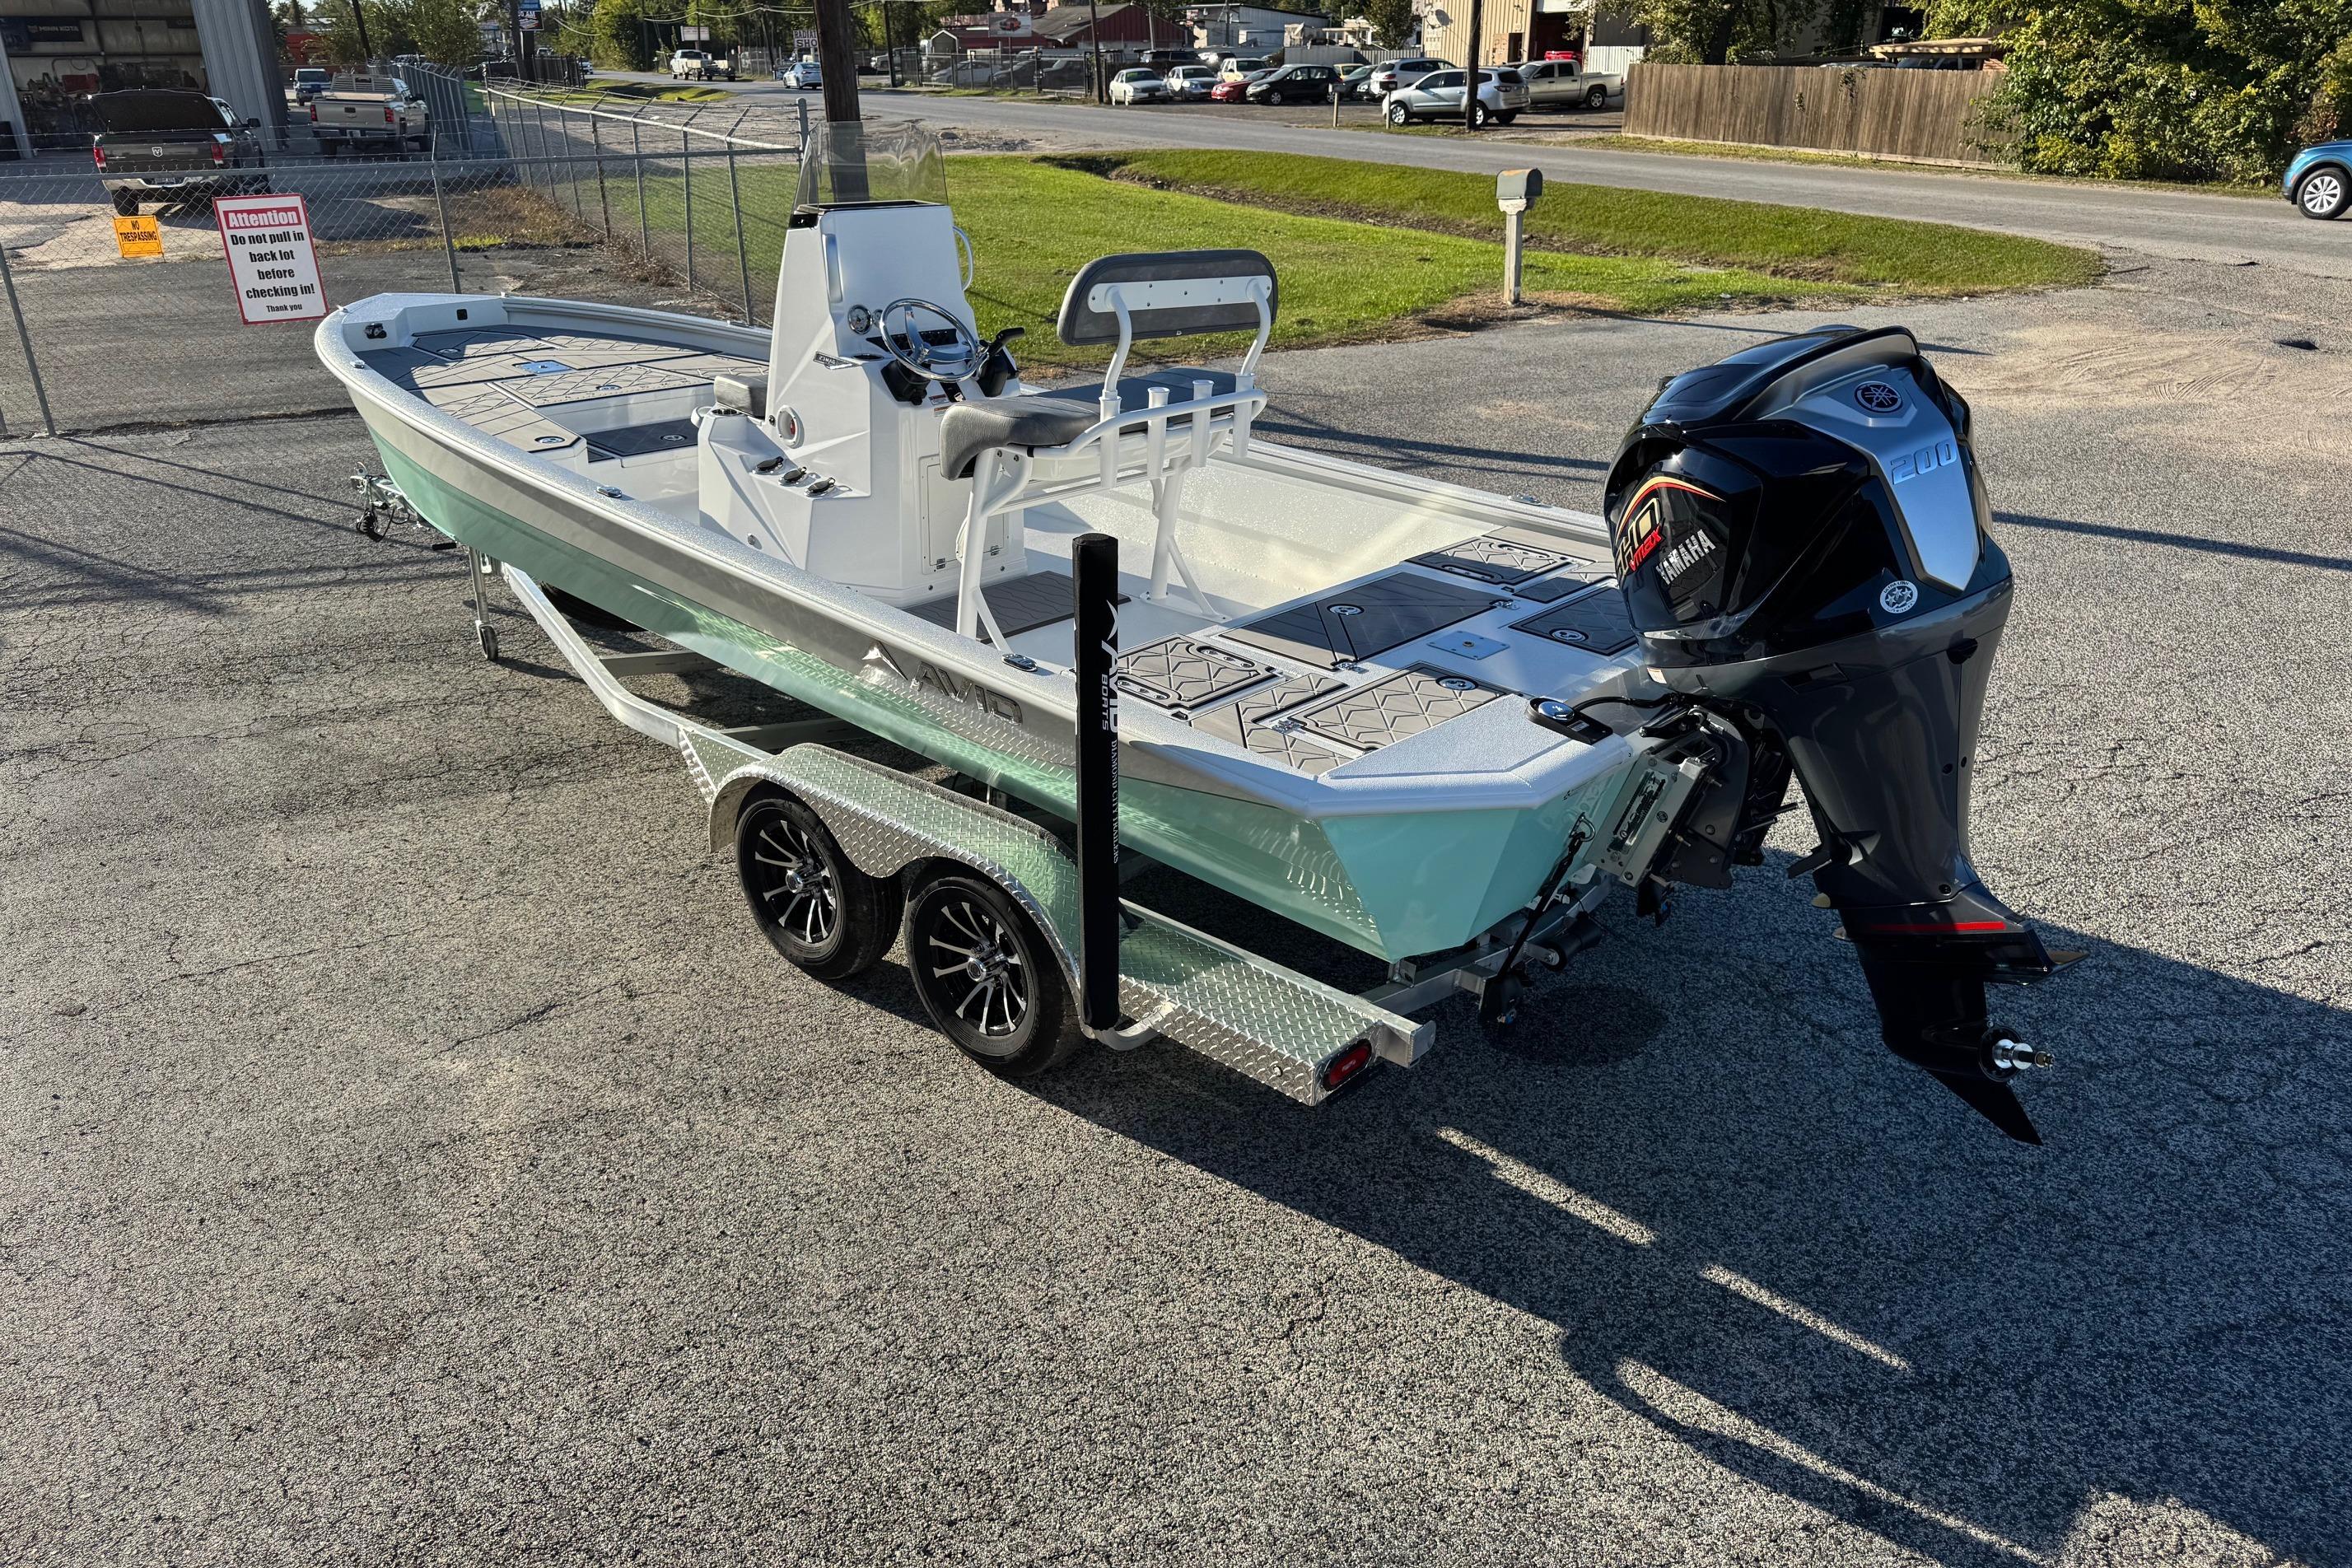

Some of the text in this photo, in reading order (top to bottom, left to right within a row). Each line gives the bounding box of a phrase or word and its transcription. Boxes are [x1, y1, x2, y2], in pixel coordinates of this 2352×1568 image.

[131, 220, 140, 231] NO
[228, 210, 298, 227] Attention
[119, 231, 157, 242] TRESPASSING
[231, 231, 305, 245] Do not pull in
[249, 250, 296, 263] back lot
[257, 268, 296, 280] before
[245, 283, 315, 299] checking in!
[266, 304, 289, 313] Thank
[1891, 438, 1958, 485] 200
[1655, 529, 1717, 586] YAMAHA
[910, 660, 1024, 725] AVID
[1101, 674, 1109, 731] BOATS
